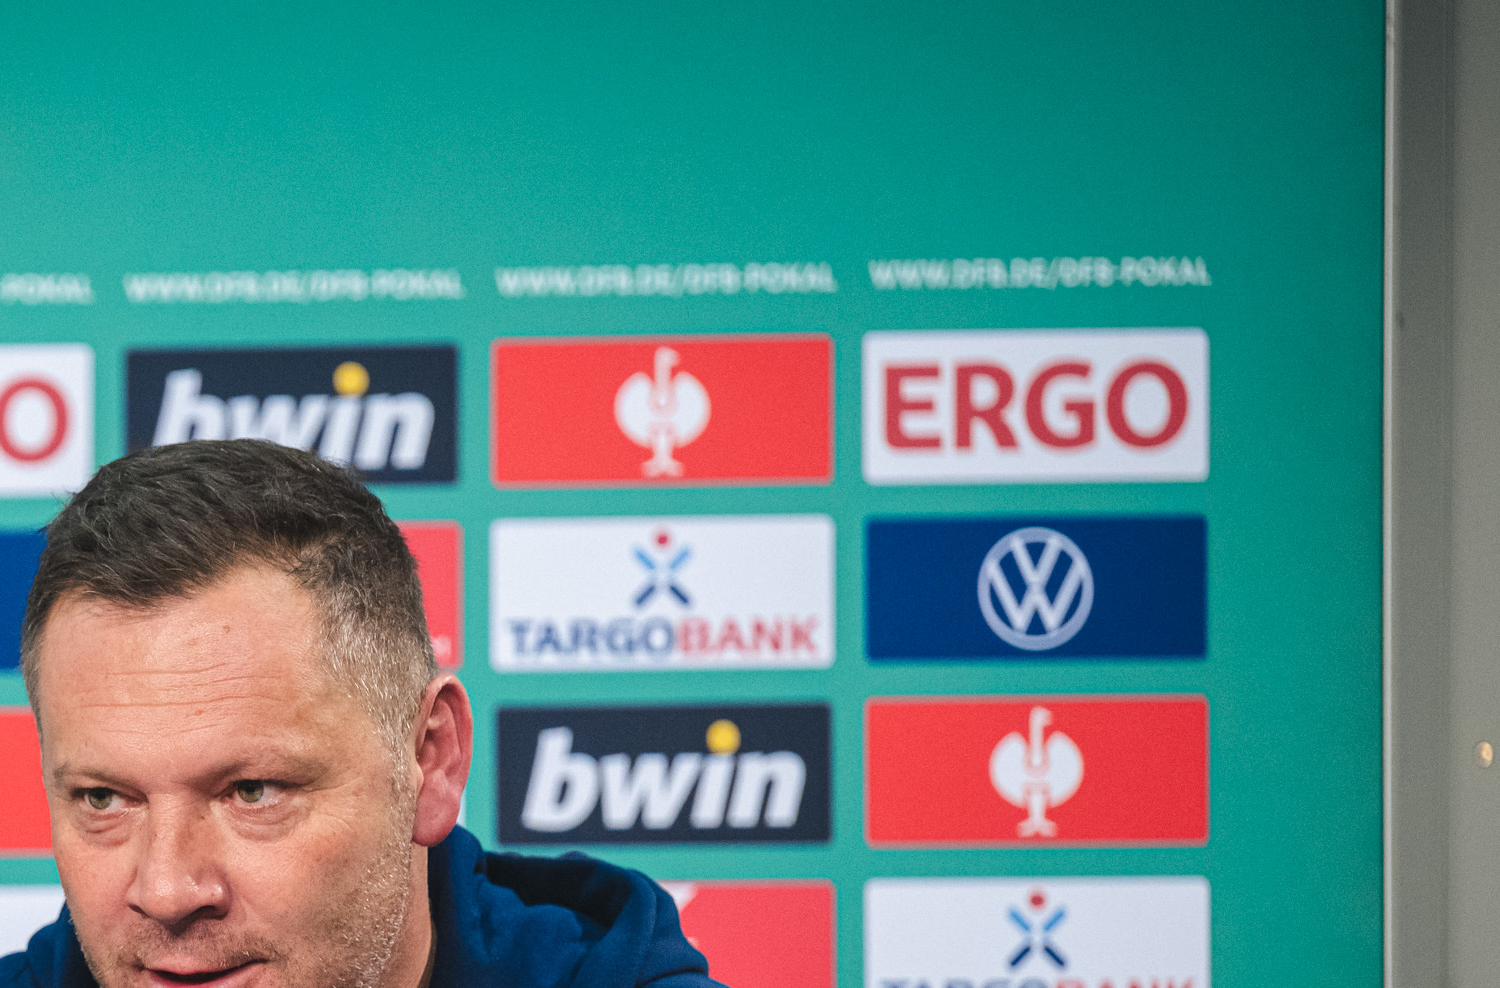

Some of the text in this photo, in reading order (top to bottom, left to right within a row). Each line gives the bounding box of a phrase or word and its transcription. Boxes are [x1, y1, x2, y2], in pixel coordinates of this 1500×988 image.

[884, 359, 1190, 451] ERGO
[511, 619, 816, 658] TARGOBANK
[522, 721, 805, 831] bwin
